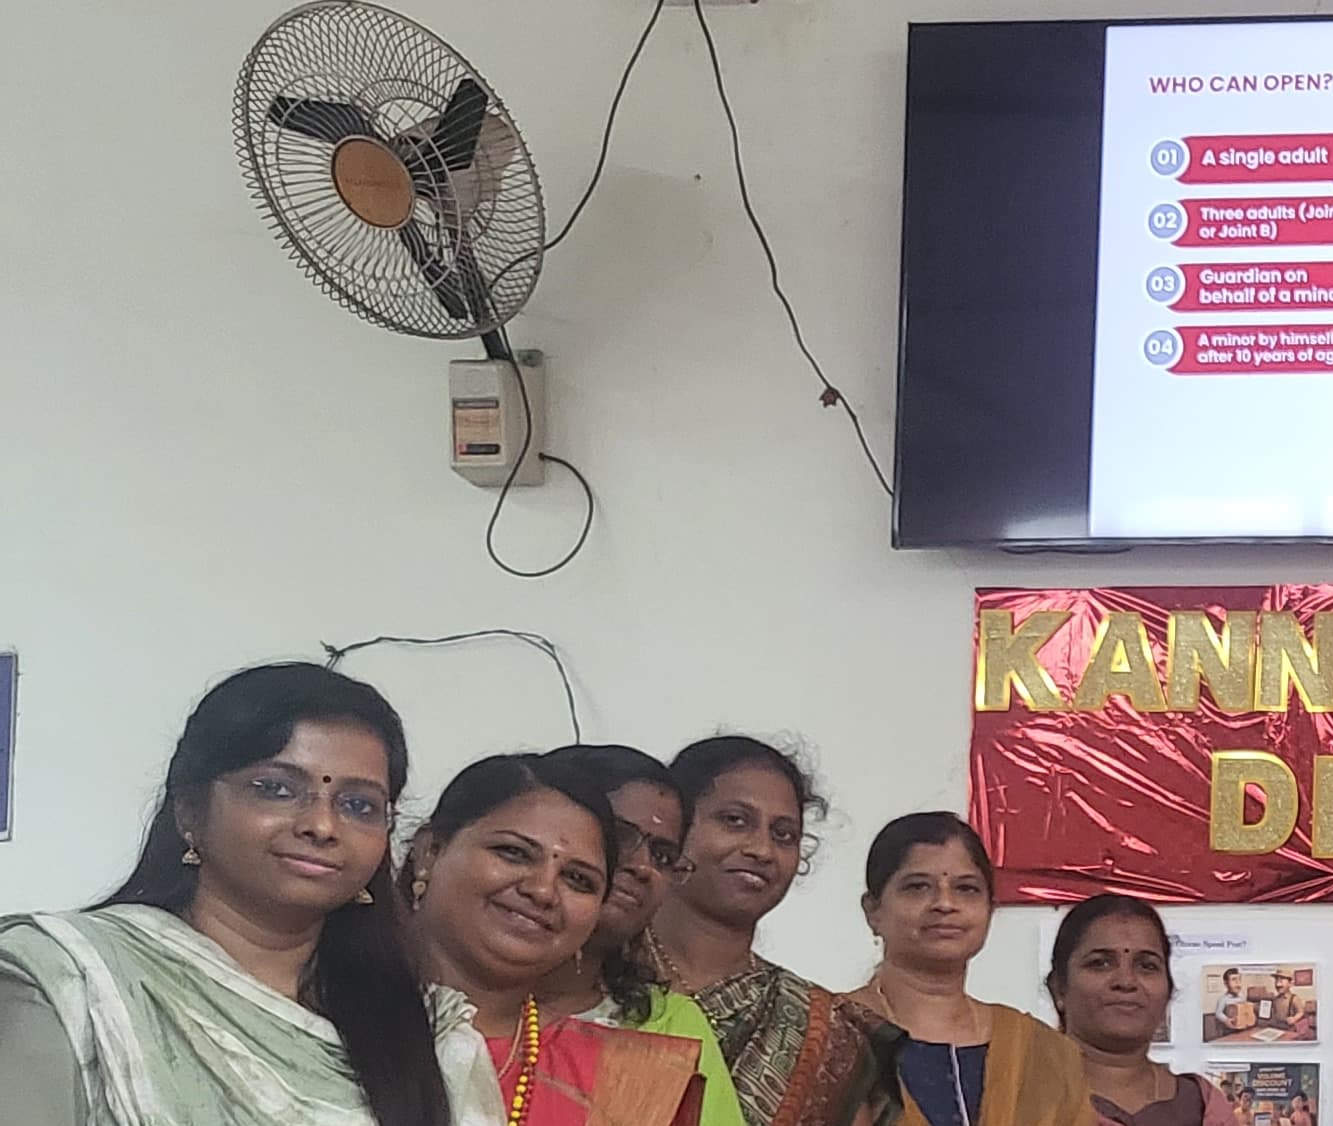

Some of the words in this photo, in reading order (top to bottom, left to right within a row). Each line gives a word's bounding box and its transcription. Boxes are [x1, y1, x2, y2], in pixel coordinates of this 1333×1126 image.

[1149, 76, 1203, 93] WHO
[1209, 75, 1258, 92] CAN
[1263, 73, 1333, 91] OPEN?
[1157, 149, 1179, 165] 01
[1201, 150, 1216, 166] A
[1219, 147, 1274, 169] single
[1278, 147, 1328, 164] adult
[1153, 212, 1178, 228] 02
[1200, 206, 1244, 221] Three
[1246, 205, 1296, 220] adults
[1199, 226, 1216, 238] or
[1218, 223, 1257, 238] Joint
[1260, 222, 1278, 239] B)
[1151, 276, 1176, 292] 03
[1200, 268, 1281, 284] Guardian
[1284, 270, 1308, 283] on
[1200, 287, 1256, 304] behalf
[1258, 287, 1277, 303] of
[1279, 291, 1291, 303] a
[1149, 339, 1174, 355] 04
[1198, 334, 1210, 347] A
[1212, 333, 1256, 346] minor
[1258, 332, 1277, 349] by
[1197, 350, 1233, 363] after
[1236, 349, 1251, 362] 10
[1254, 349, 1295, 366] years
[1297, 348, 1314, 361] of
